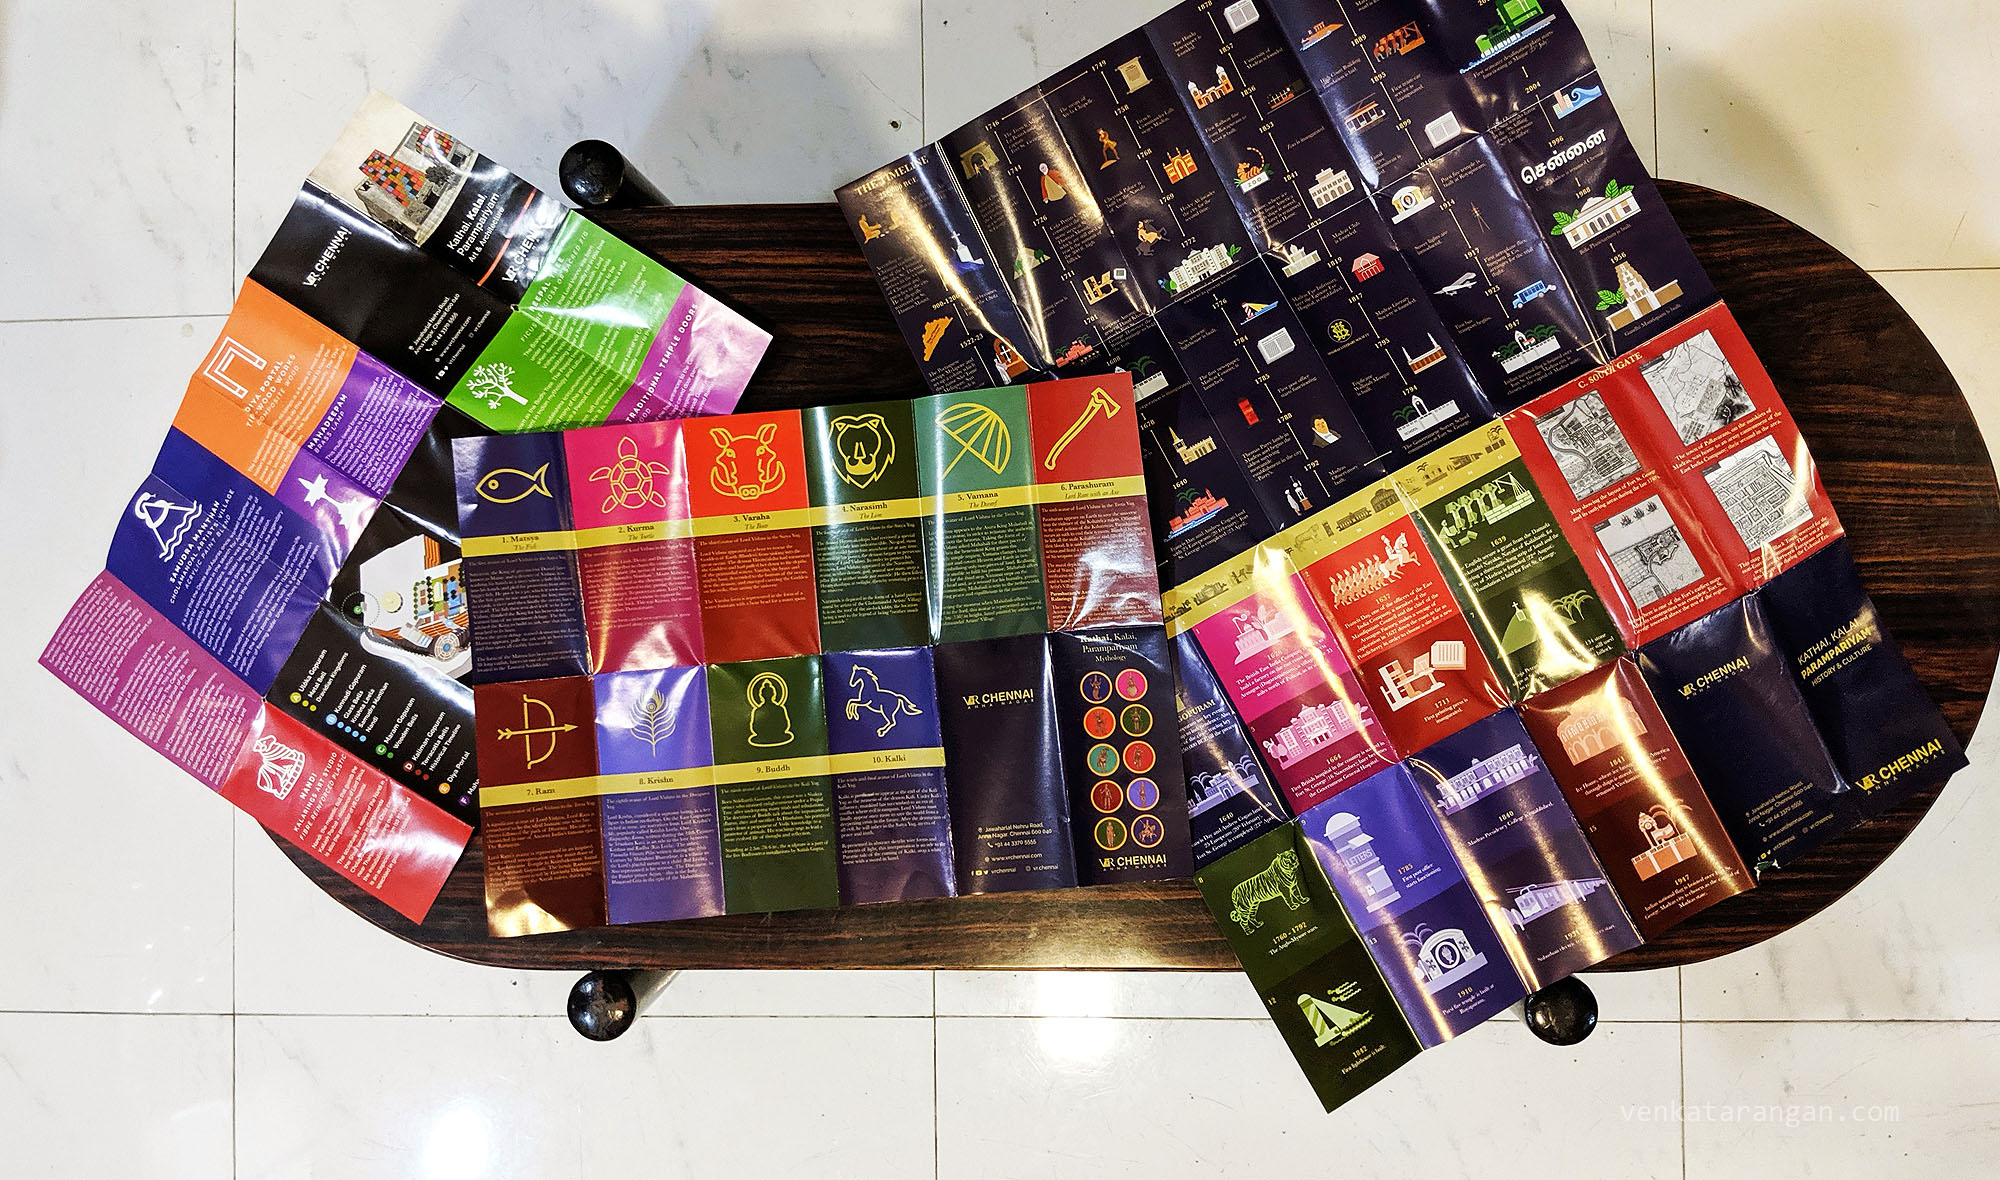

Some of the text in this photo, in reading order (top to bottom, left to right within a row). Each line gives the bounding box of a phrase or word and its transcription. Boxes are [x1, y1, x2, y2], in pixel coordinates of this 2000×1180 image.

[1196, 0, 1213, 12] 1878
[1349, 33, 1367, 47] 1889
[1218, 42, 1235, 54] 1857
[1370, 71, 1387, 84] 1895
[1523, 80, 1541, 94] 2004
[1394, 118, 1412, 131] 1899
[1547, 135, 1564, 148] 1996
[1136, 147, 1153, 160] 1768
[1517, 125, 1611, 186] சென்னை
[1282, 170, 1299, 182] 1841
[854, 179, 877, 197] THE
[1158, 191, 1175, 204] 1769
[1438, 198, 1455, 211] 1914
[455, 192, 503, 257] Parampariyam
[1031, 214, 1048, 227] 1726
[467, 205, 507, 263] Art & Architecture
[1180, 235, 1196, 248] 1772
[312, 224, 350, 274] CHENNAI
[1463, 247, 1480, 260] 1917
[1609, 251, 1627, 264] 1956
[1060, 269, 1076, 281] 1711
[1211, 297, 1228, 309] 1776
[1347, 292, 1363, 304] 1817
[1504, 318, 1521, 331] 1947
[1232, 334, 1248, 346] 1784
[1374, 336, 1390, 349] 1795
[273, 352, 297, 384] WORKS
[624, 302, 700, 425] TRADITIONAL TEMPLE DOORS
[1577, 378, 1588, 389] C.
[1615, 350, 1643, 370] GATE
[1254, 372, 1270, 384] 1785
[244, 358, 284, 414] DIYA PORTAL
[307, 392, 348, 450] MAHADEEPAM
[314, 409, 346, 454] BRASS LAMP
[1302, 459, 1320, 471] 1792
[1068, 480, 1114, 490] Parashuram
[966, 491, 998, 500] Vamana
[849, 502, 887, 511] Narasimh
[742, 513, 770, 521] Varaha
[627, 524, 654, 532] Kurma
[165, 499, 222, 583] SAMUDRA MANTHAN
[510, 534, 539, 544] Matsya
[1489, 534, 1507, 548] 1639
[163, 551, 204, 604] CHOLAMANDAL
[213, 488, 238, 519] VILLAGE
[180, 513, 234, 589] ACRYLIC PAINT BLEND
[1374, 592, 1391, 605] 1637
[1113, 630, 1137, 642] Kalai,
[1794, 636, 1834, 665] KATHAI,
[1795, 626, 1876, 679] PARAMPARIYAM
[306, 647, 330, 677] Gopuram
[1095, 653, 1127, 663] Mythology
[1809, 665, 1838, 686] HISTORY
[1840, 642, 1873, 666] CULTURE
[314, 650, 351, 702] Dravidian Kingdoms
[1695, 653, 1750, 691] CHENNAI
[306, 669, 327, 698] Metal Bell
[332, 662, 370, 714] Kannadi Gopuram
[962, 689, 1033, 705] VR CHENNAI
[1433, 696, 1450, 709] 1711
[364, 714, 379, 733] Nandi
[382, 695, 418, 744] Maram Gopuram
[424, 710, 448, 740] Gopuram
[427, 722, 462, 772] Historical Timeline
[885, 754, 906, 762] Kalki
[1325, 752, 1342, 765] 1664
[1855, 737, 1943, 792] VR CHENNAI
[446, 749, 470, 783] Diya Portal
[765, 764, 790, 772] Buddh
[297, 771, 320, 800] NANDI
[647, 776, 673, 784] Krishn
[289, 750, 340, 832] KALARINGS ART STUDIO
[297, 753, 350, 841] FIBRE REINFORCED PLASTIC
[1497, 809, 1514, 822] 1840
[1099, 853, 1166, 868] VR CHENNAI
[1344, 846, 1373, 868] LETTERS
[1673, 873, 1690, 886] 1947
[1271, 931, 1288, 944] 1760
[1290, 921, 1307, 934] 1792
[1456, 986, 1473, 998] 1910
